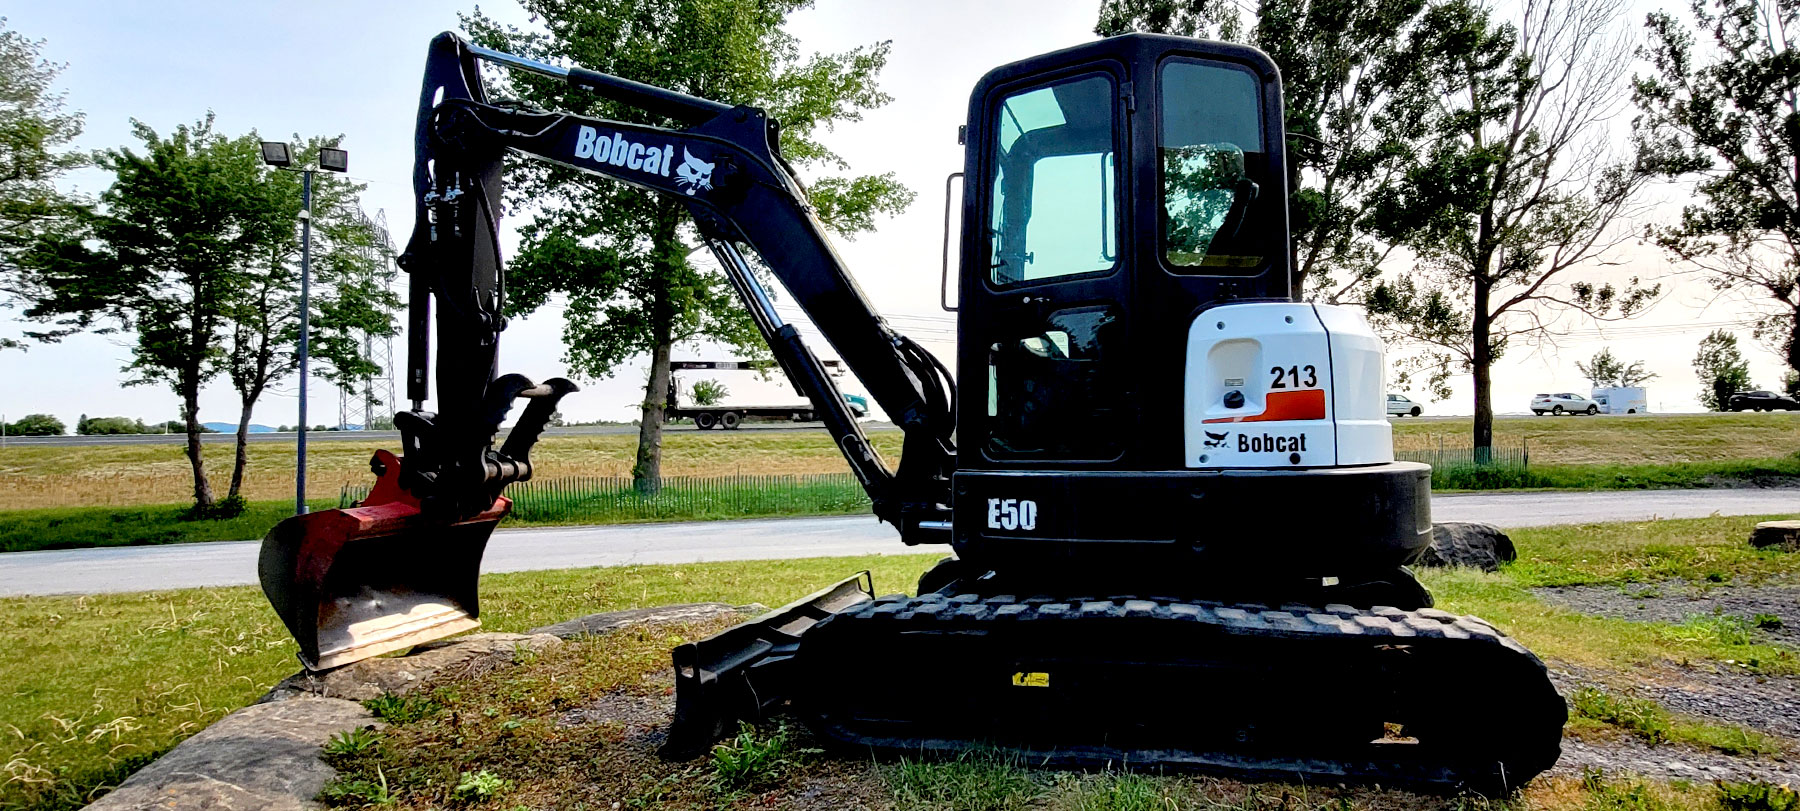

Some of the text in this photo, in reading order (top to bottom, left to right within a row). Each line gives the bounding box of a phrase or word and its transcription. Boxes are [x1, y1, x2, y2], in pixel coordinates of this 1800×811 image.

[574, 125, 674, 178] Bobcat
[1270, 365, 1317, 388] 213
[1238, 433, 1307, 453] Bobcat
[988, 498, 1037, 531] E50
